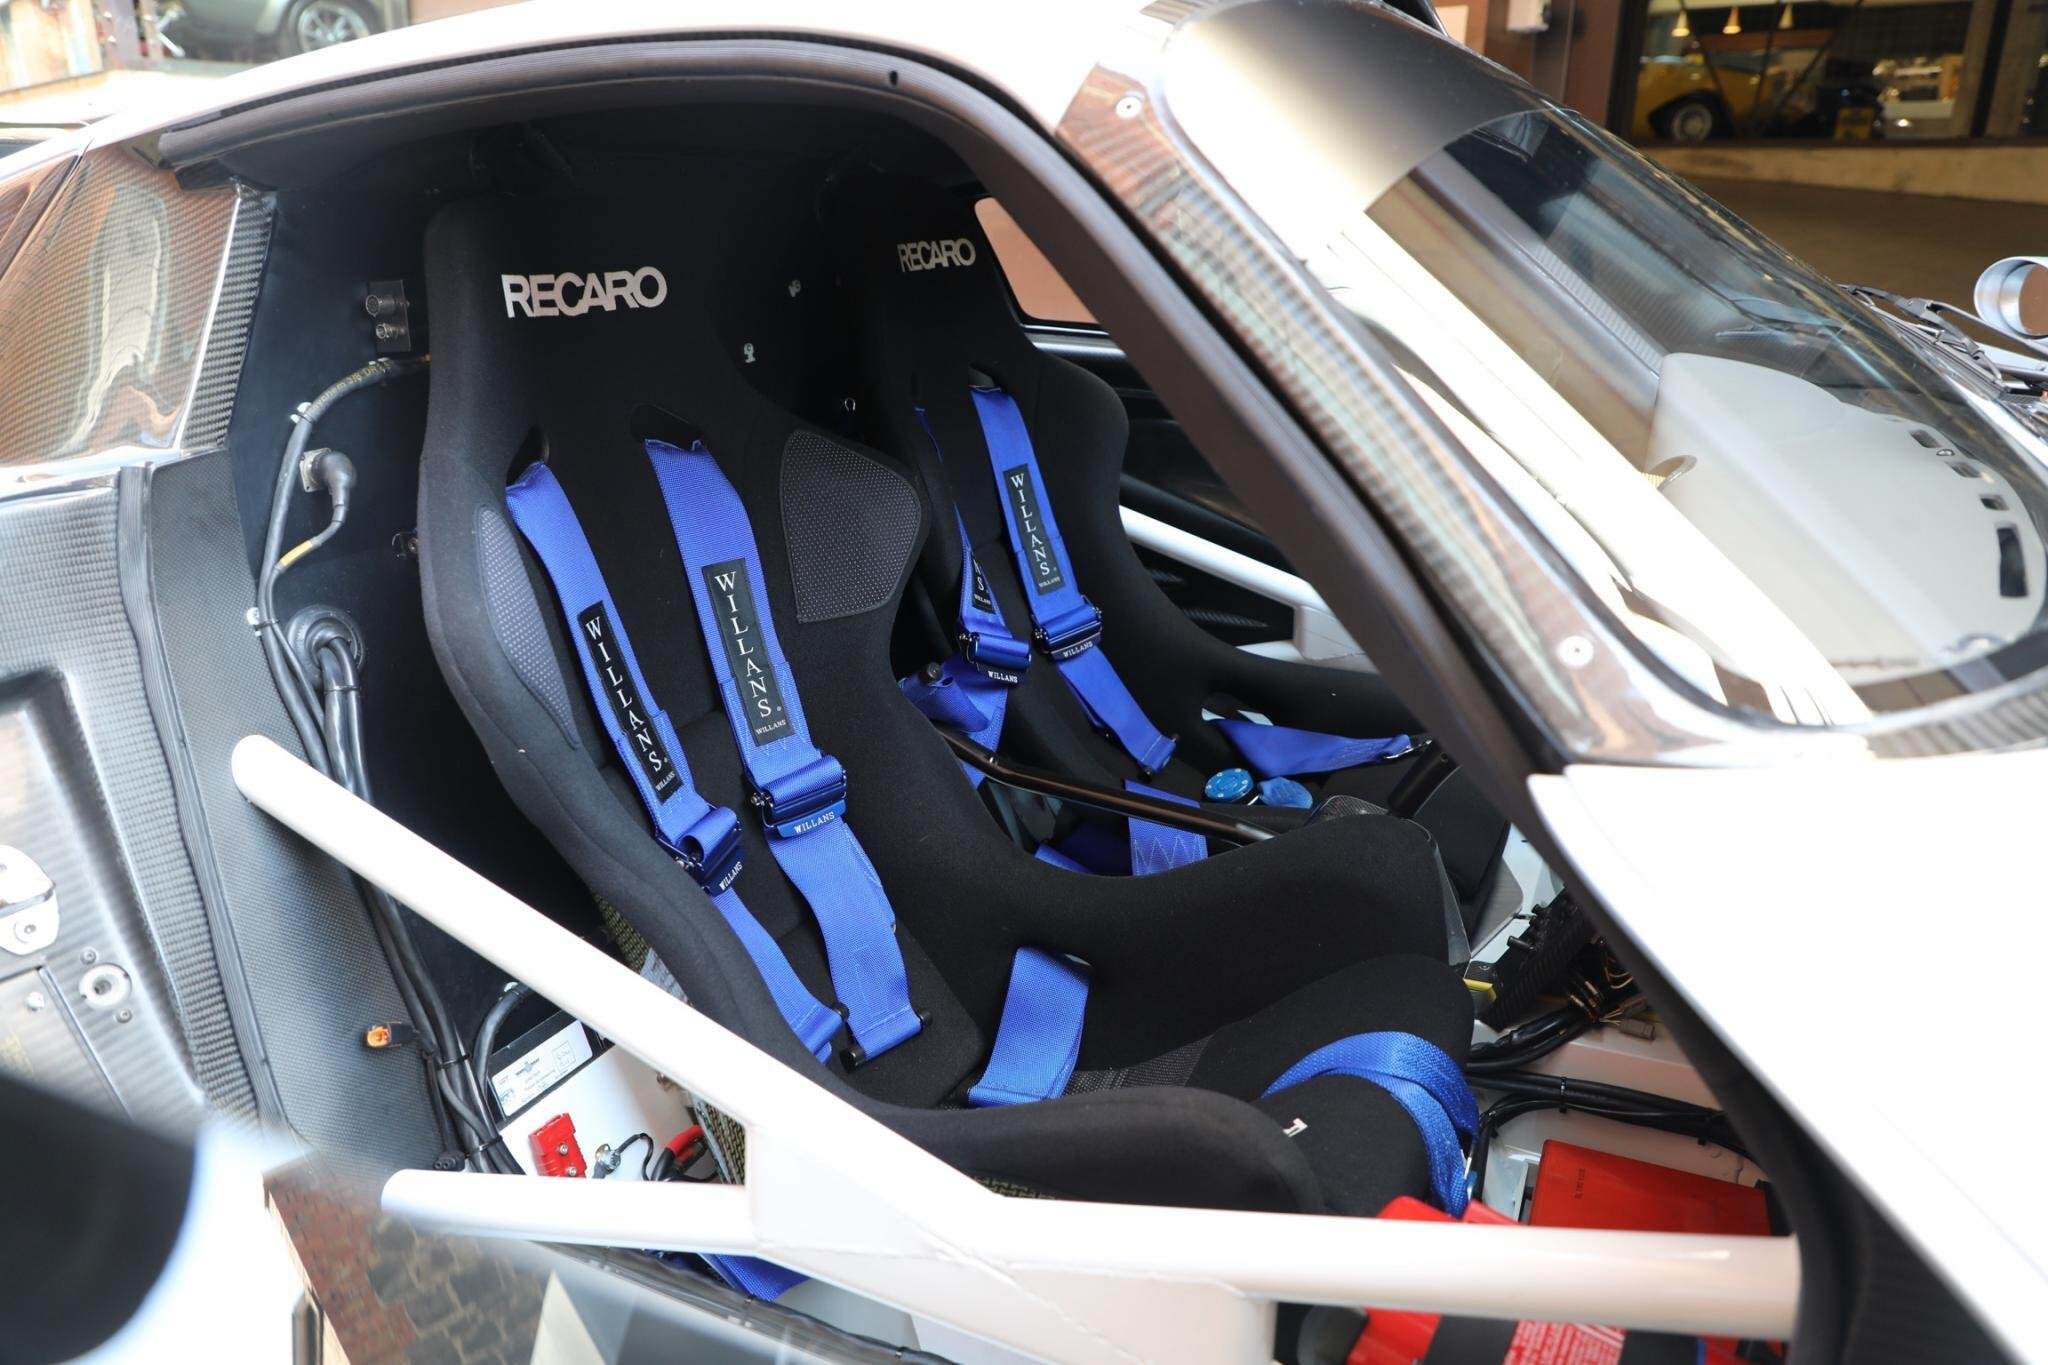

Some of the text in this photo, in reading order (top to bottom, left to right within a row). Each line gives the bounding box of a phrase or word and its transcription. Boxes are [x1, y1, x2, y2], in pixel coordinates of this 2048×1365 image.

[897, 238, 976, 272] RECARO
[501, 266, 667, 318] RECARO
[1010, 473, 1050, 576] WILLANS
[715, 571, 772, 718] WILLANS
[1063, 641, 1094, 658] WILLANS
[988, 670, 1018, 684] WILLANS
[585, 616, 662, 773] WILLANS
[755, 719, 787, 736] WILLANS
[655, 770, 676, 792] WILLANS
[793, 811, 836, 834] WILLANS
[718, 861, 744, 891] WILLANS
